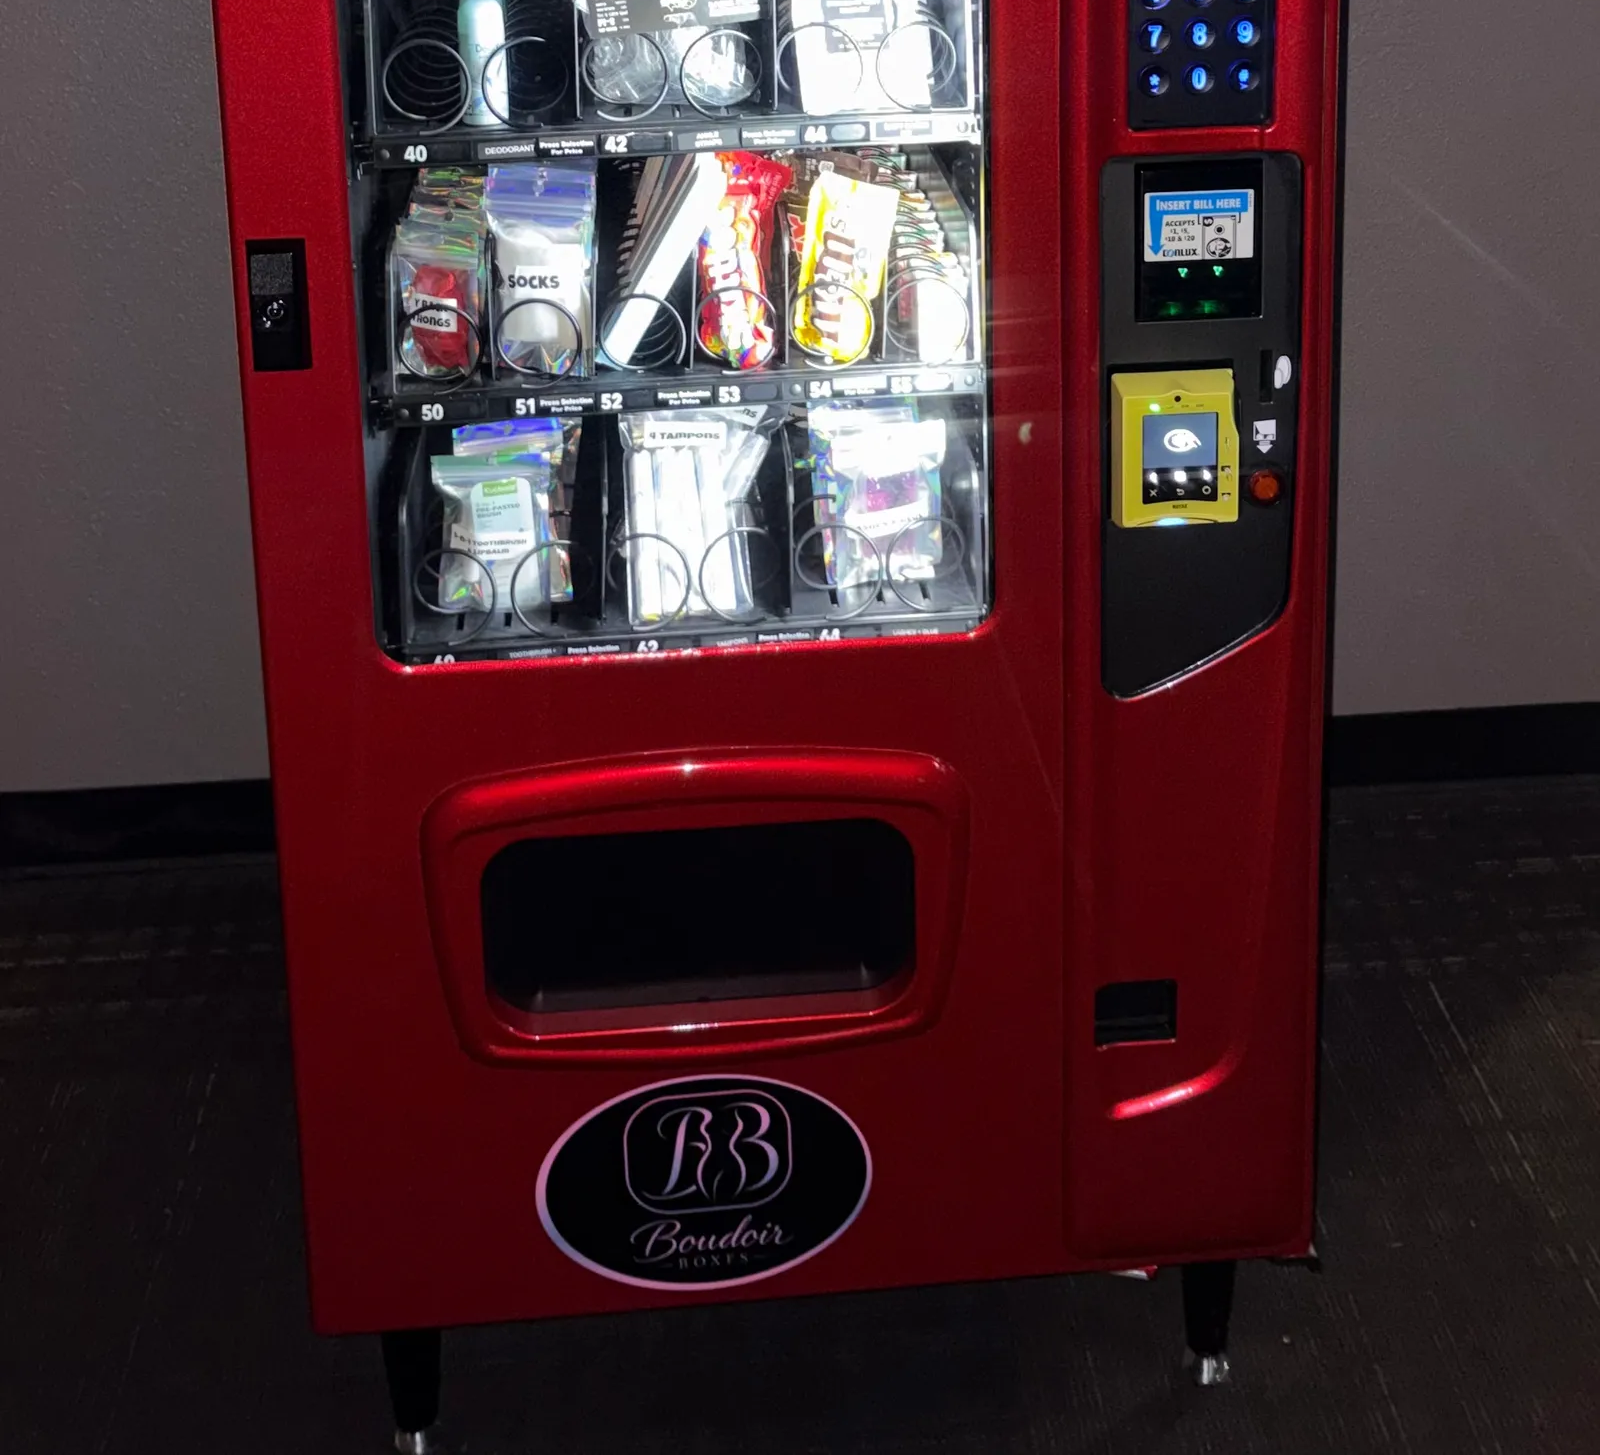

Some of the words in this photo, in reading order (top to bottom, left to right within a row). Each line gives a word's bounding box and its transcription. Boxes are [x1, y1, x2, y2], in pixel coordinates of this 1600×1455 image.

[1148, 25, 1163, 47] 7
[1192, 22, 1208, 46] 8
[1236, 20, 1254, 44] 9
[1191, 67, 1207, 91] 0
[803, 125, 828, 144] 44
[484, 144, 535, 156] DEODORANT
[604, 135, 628, 153] 42
[403, 144, 428, 163] 40
[1155, 199, 1191, 212] INSERT
[1193, 198, 1214, 210] BILL
[1216, 197, 1241, 209] HERE
[1165, 219, 1196, 227] ACCEPTS
[507, 274, 561, 289] SOCKS
[414, 297, 420, 307] Y
[718, 385, 741, 403] 53
[809, 380, 832, 399] 54
[514, 398, 536, 416] 51
[600, 392, 623, 410] 52
[421, 402, 444, 422] 50
[649, 432, 656, 440] 4
[567, 646, 587, 655] Press
[587, 644, 620, 653] Selection
[630, 1214, 794, 1264] Boudoir
[678, 1252, 750, 1271] BOXES
